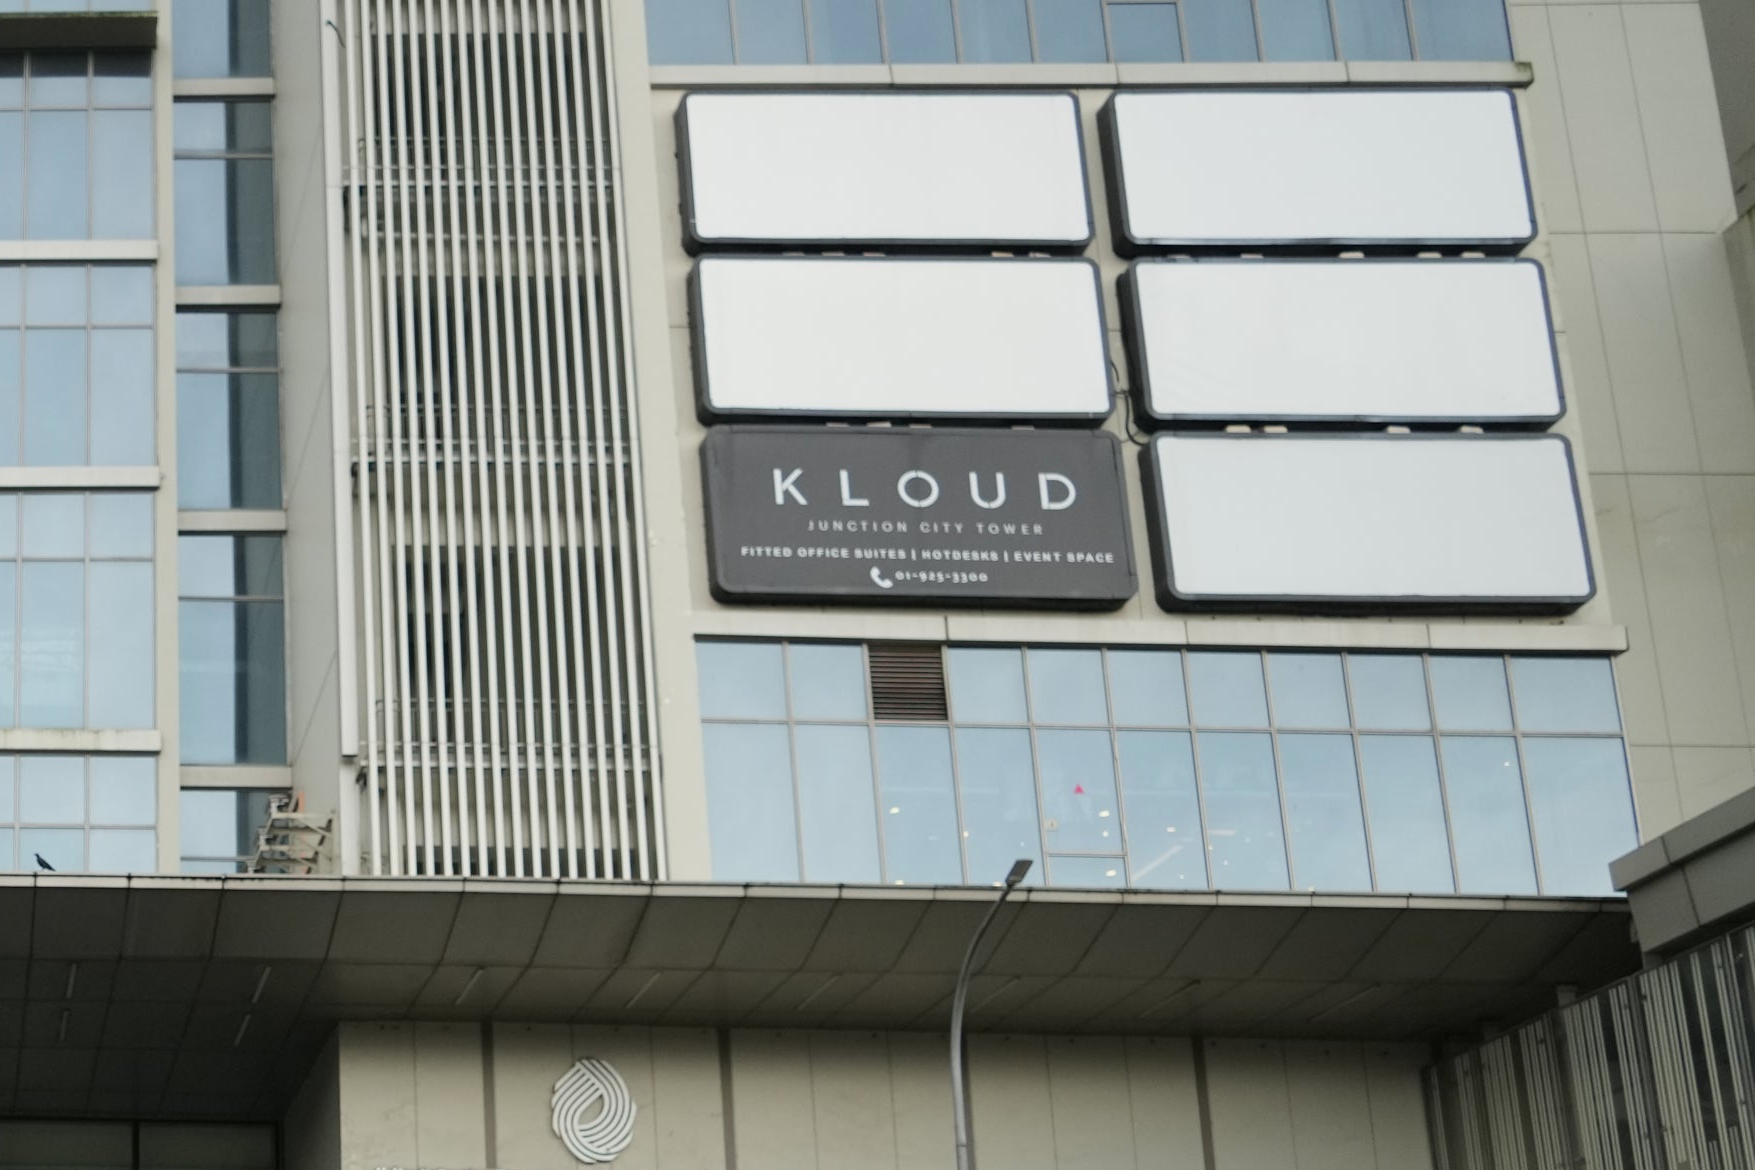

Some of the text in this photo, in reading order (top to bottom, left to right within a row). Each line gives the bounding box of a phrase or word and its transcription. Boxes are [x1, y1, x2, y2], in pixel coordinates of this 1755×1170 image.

[772, 467, 1077, 510] KLOUD
[807, 519, 1044, 536] JUNCTION CITY TOWER
[741, 546, 1115, 564] FITTED OFFICE SUITES HOTDESKS EVENT SPACE
